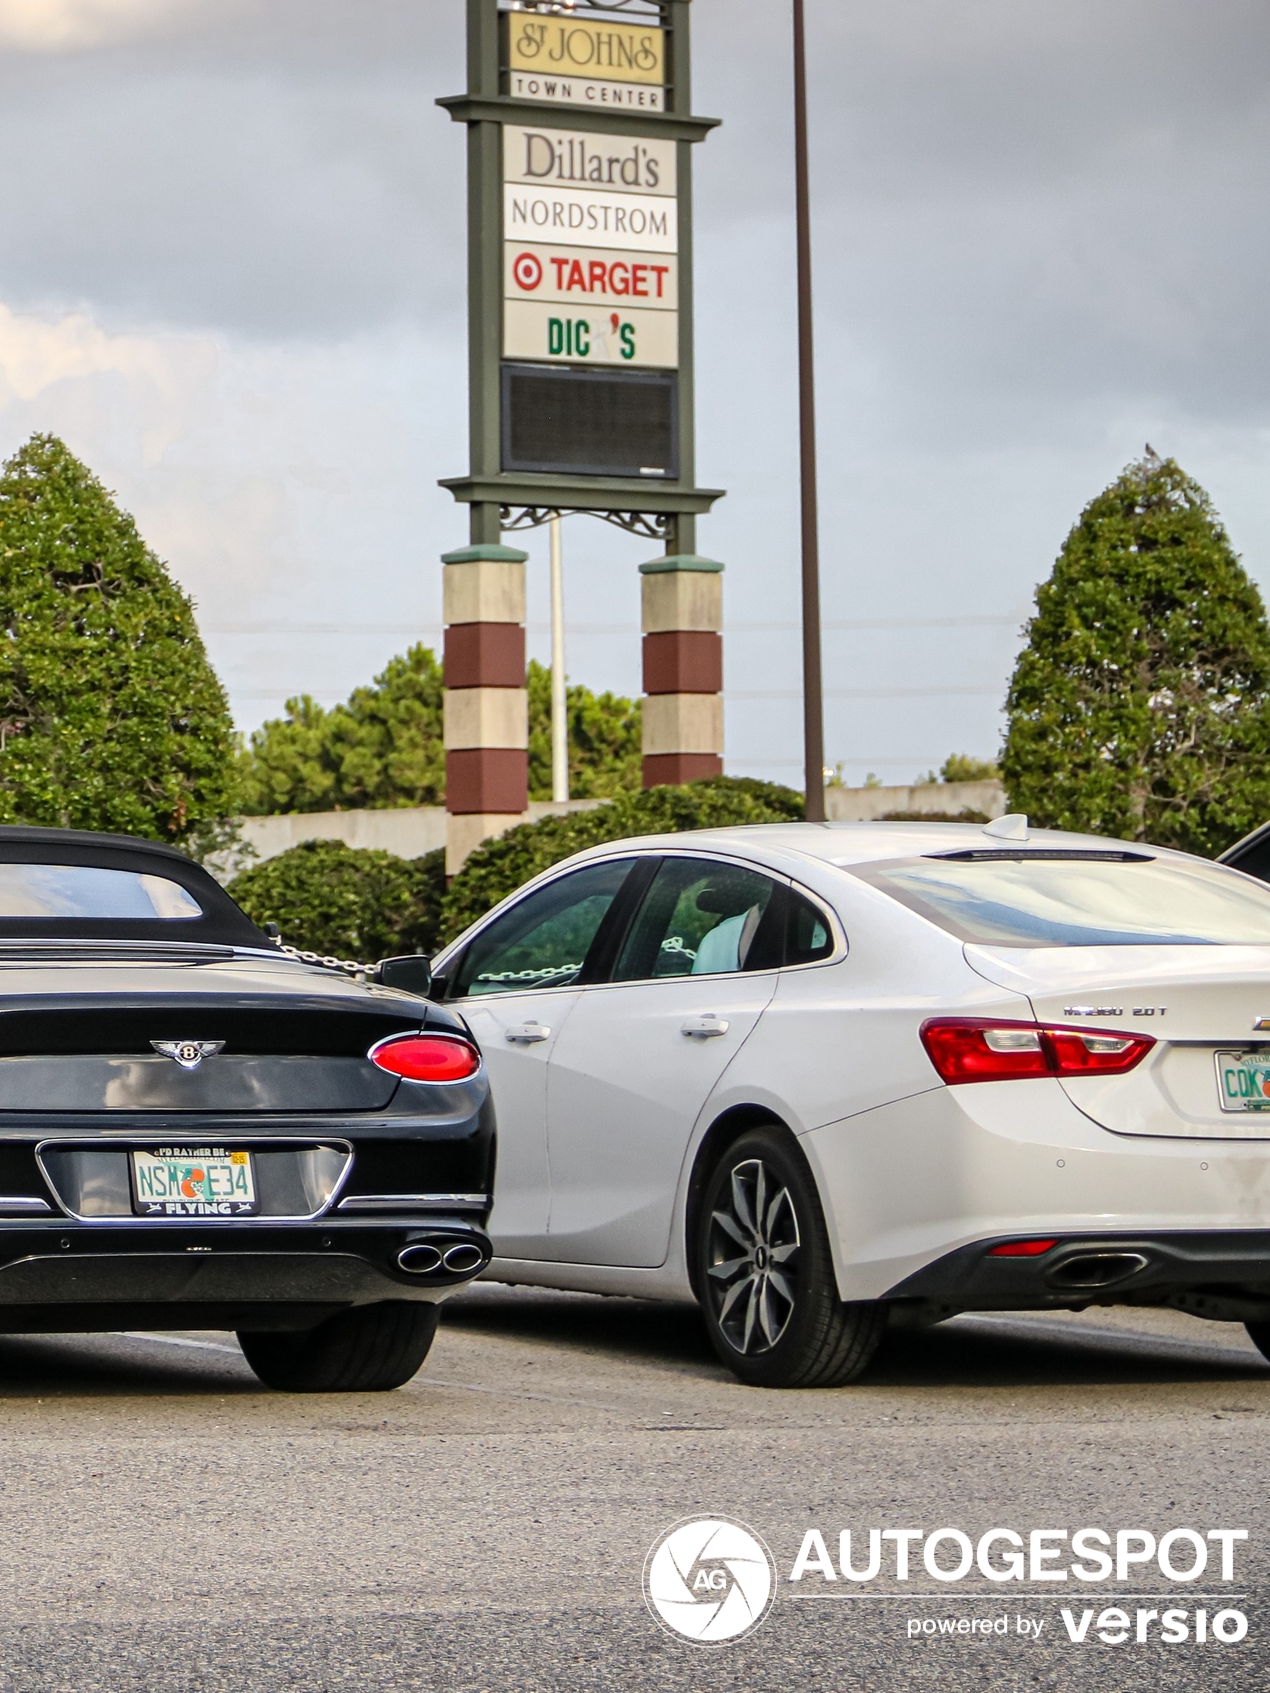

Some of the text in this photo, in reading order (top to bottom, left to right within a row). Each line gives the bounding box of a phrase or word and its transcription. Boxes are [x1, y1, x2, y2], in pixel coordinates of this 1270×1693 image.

[549, 28, 658, 71] JOHNS
[517, 79, 658, 106] TOWN CENTER
[523, 133, 659, 188] Dillard's
[512, 199, 668, 236] NORDSTROM
[550, 257, 669, 297] TARGET
[182, 1046, 195, 1059] B
[159, 1148, 225, 1156] I'D RATHER BE
[165, 1203, 231, 1214] FLYING
